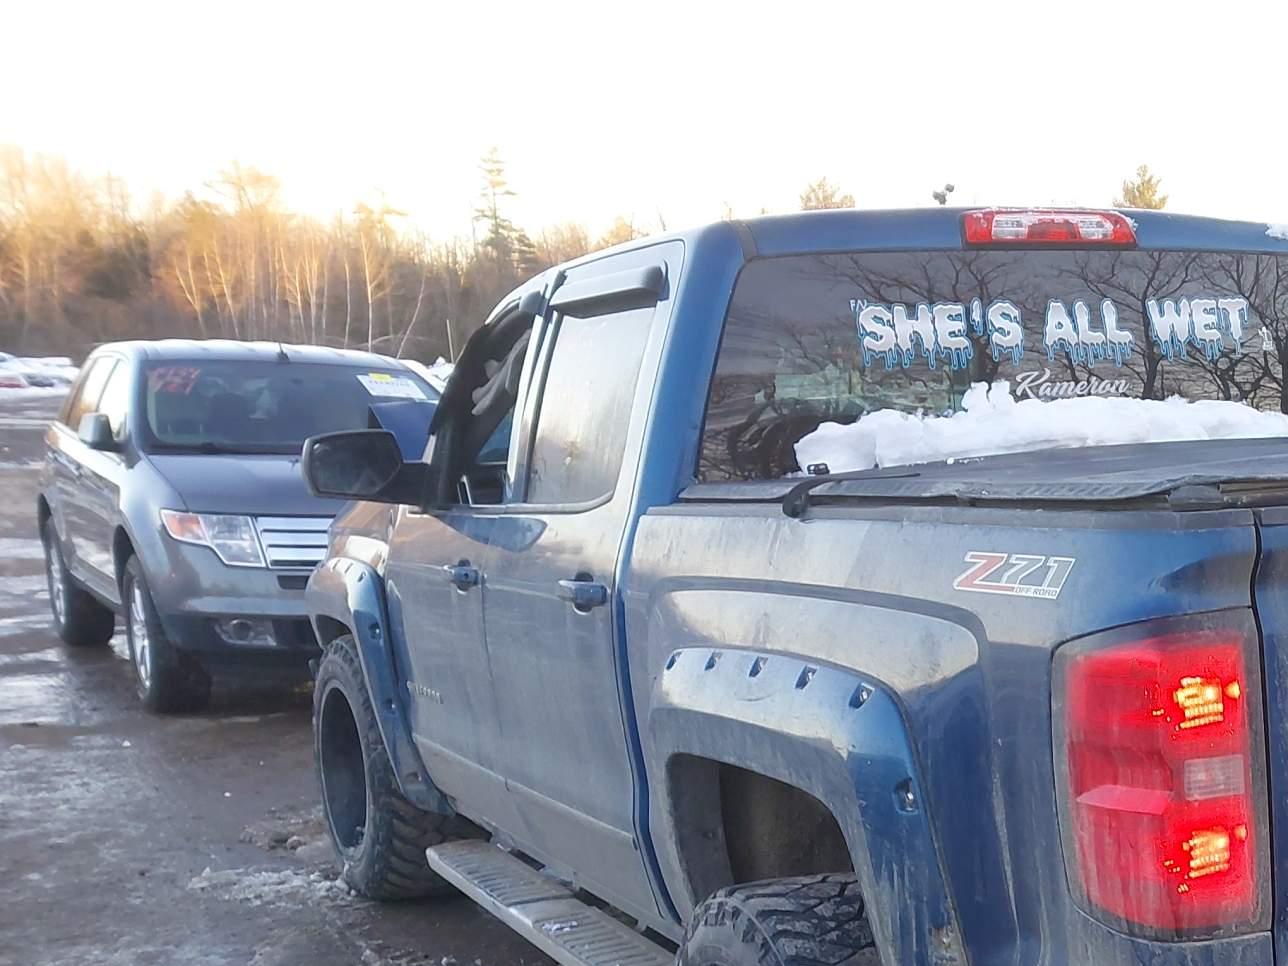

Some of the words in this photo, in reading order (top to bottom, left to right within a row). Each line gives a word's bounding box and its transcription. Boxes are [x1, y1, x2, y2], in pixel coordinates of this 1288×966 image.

[857, 297, 1024, 370] SHE'S
[1044, 298, 1135, 368] ALL
[1145, 297, 1249, 362] WET
[1015, 367, 1130, 400] Kameron
[952, 550, 1076, 599] Z71
